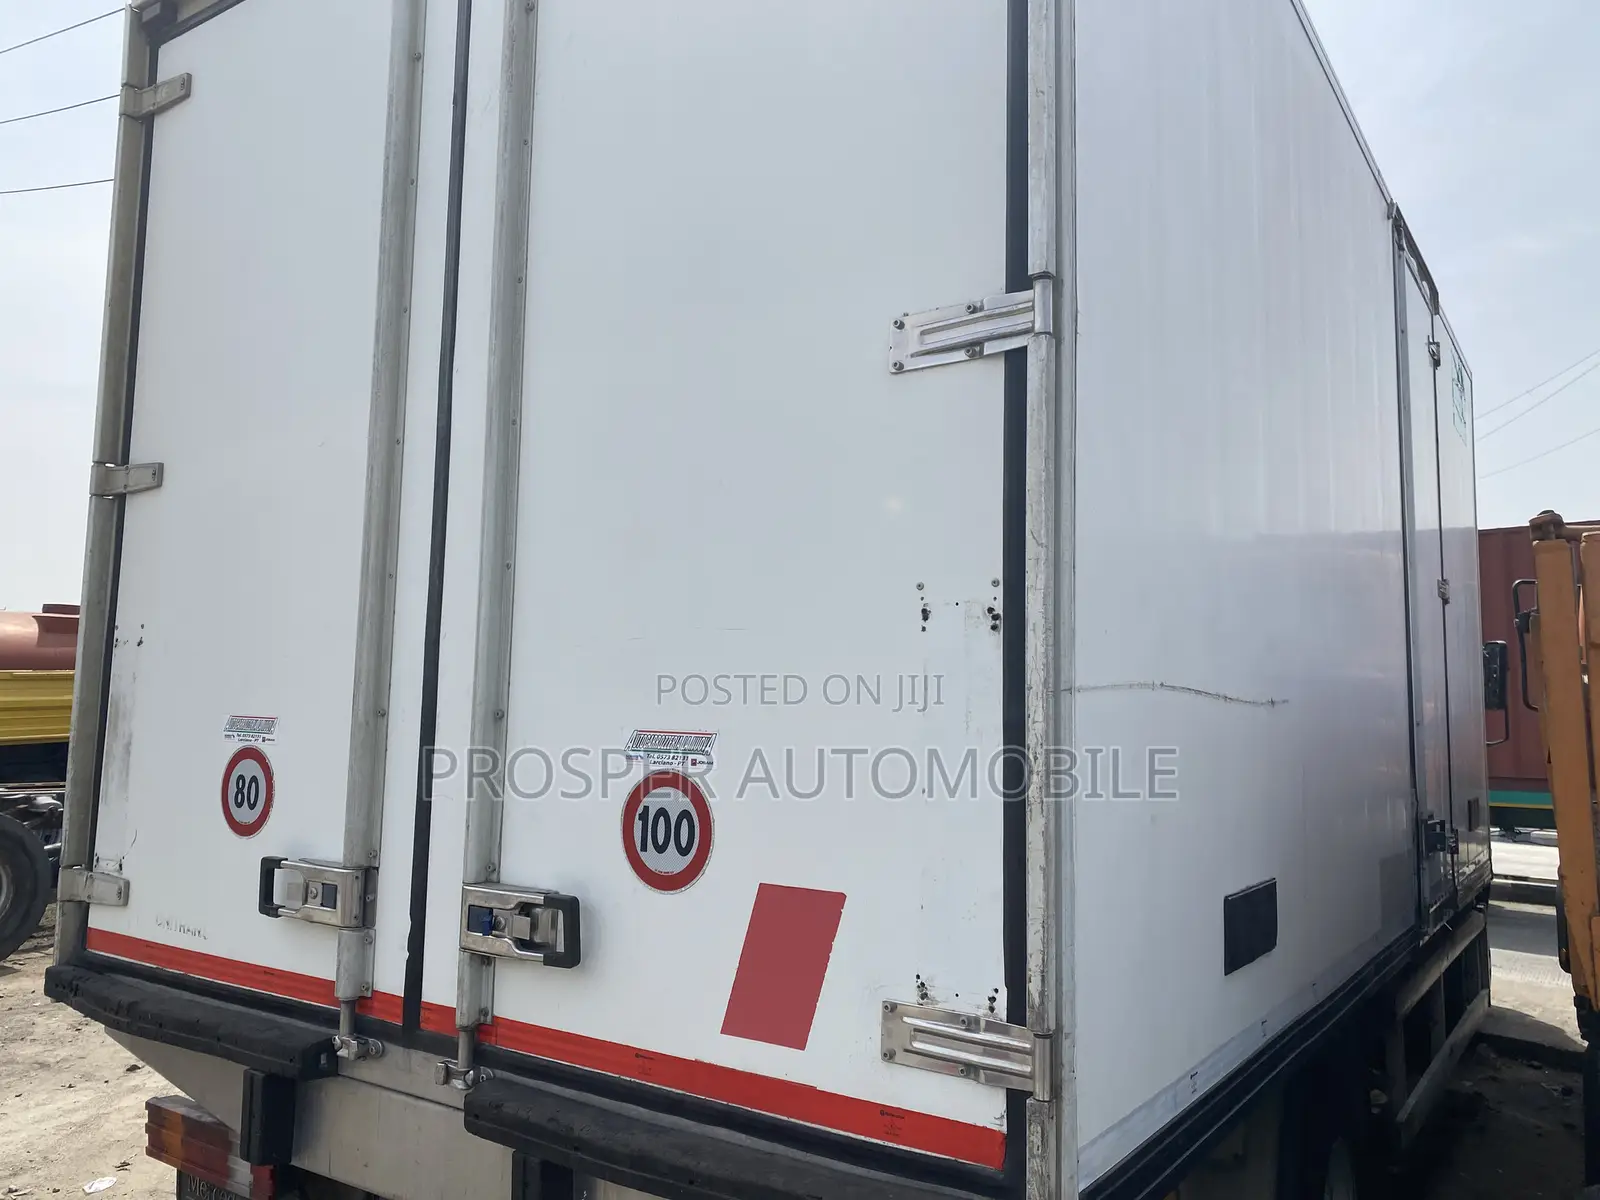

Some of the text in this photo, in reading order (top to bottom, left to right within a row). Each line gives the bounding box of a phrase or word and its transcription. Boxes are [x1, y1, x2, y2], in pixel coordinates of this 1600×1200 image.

[649, 759, 674, 767] Larciano
[233, 773, 260, 811] 80
[637, 804, 696, 858] 100
